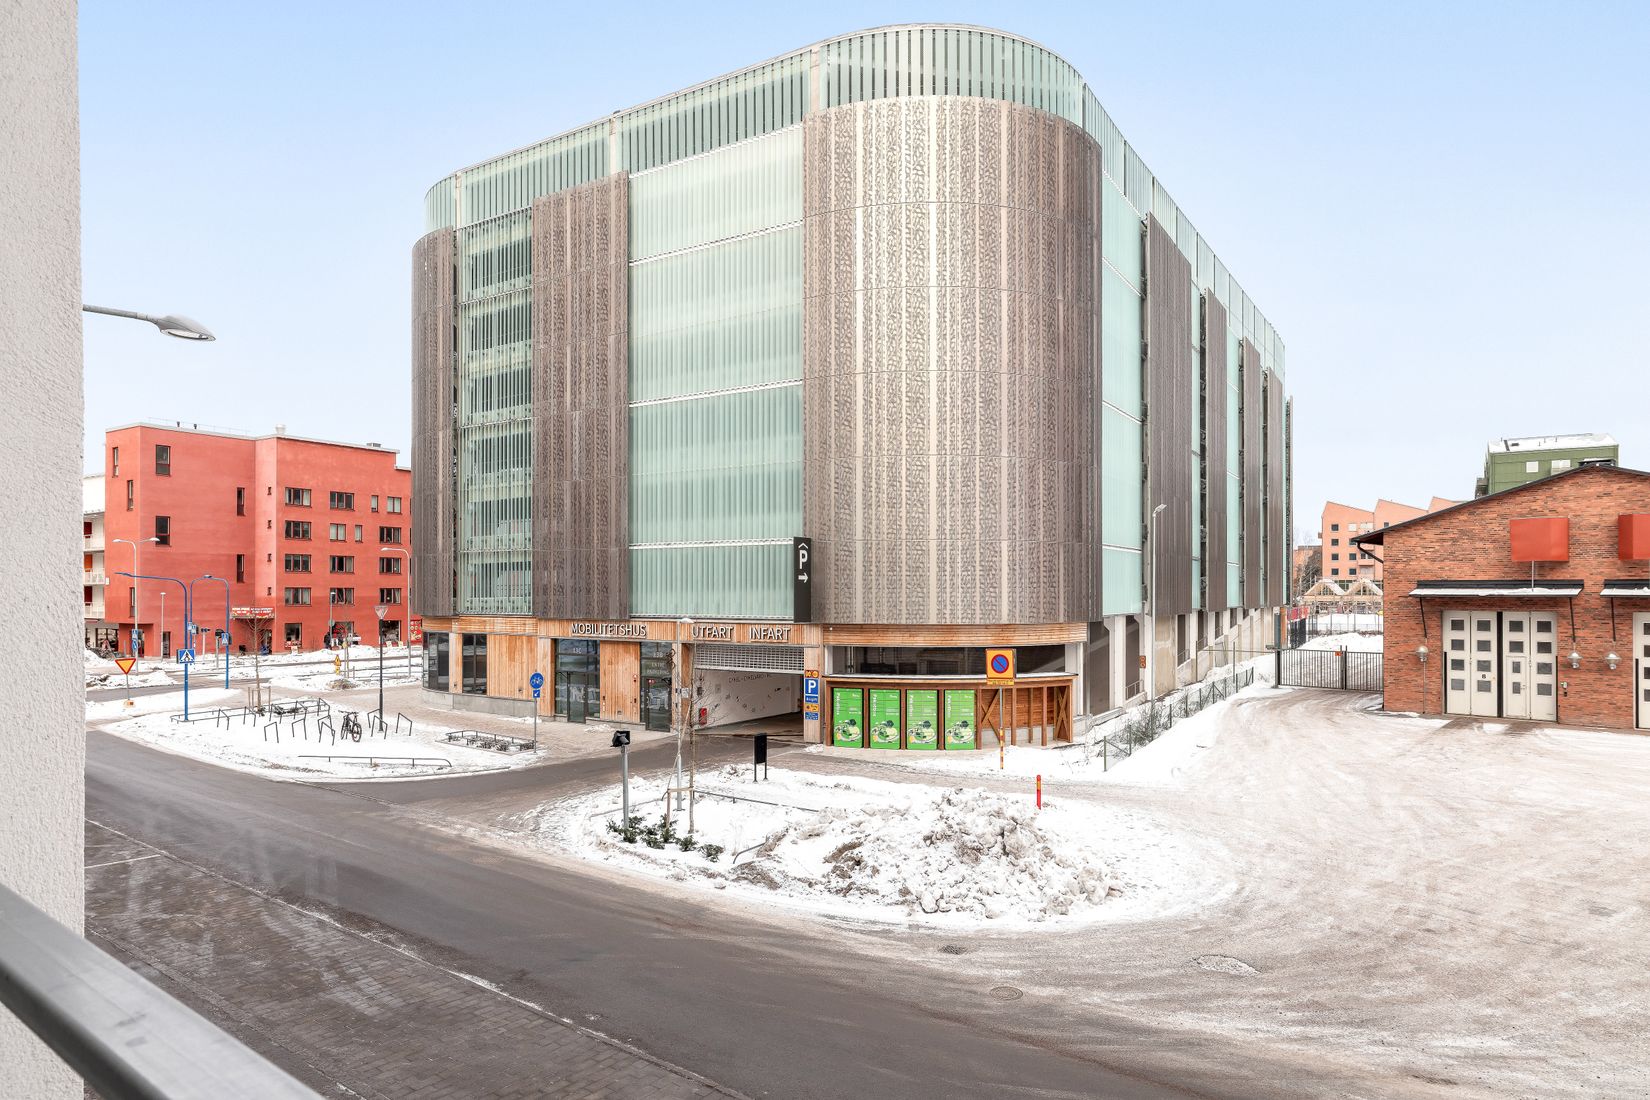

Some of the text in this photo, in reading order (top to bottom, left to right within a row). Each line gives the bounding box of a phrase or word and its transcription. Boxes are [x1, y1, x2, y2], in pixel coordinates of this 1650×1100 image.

[799, 549, 808, 570] P
[571, 623, 647, 637] MOBILITETSHUS
[692, 626, 734, 639] UTFART
[750, 627, 791, 641] INFART
[808, 680, 817, 693] P
